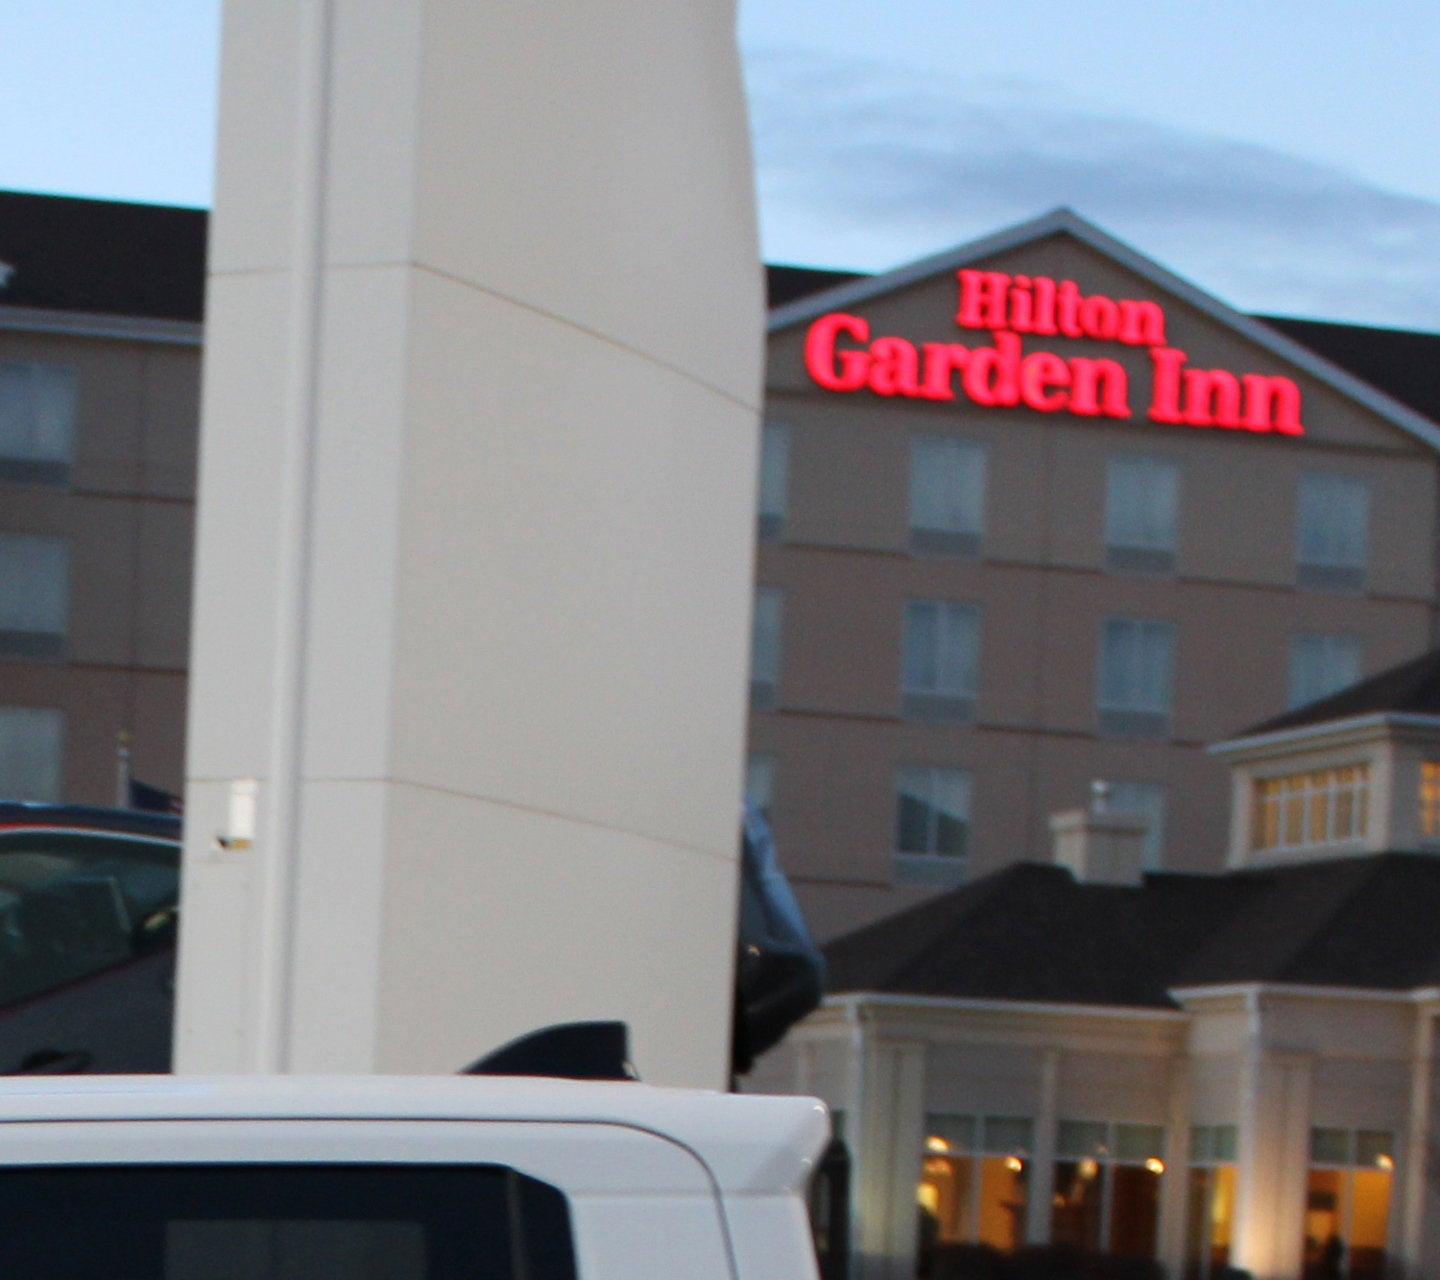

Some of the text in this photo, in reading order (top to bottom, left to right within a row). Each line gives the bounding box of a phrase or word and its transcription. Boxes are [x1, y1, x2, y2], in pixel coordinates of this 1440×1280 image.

[957, 268, 1165, 346] Hilton
[805, 313, 1304, 435] Garden Inn
